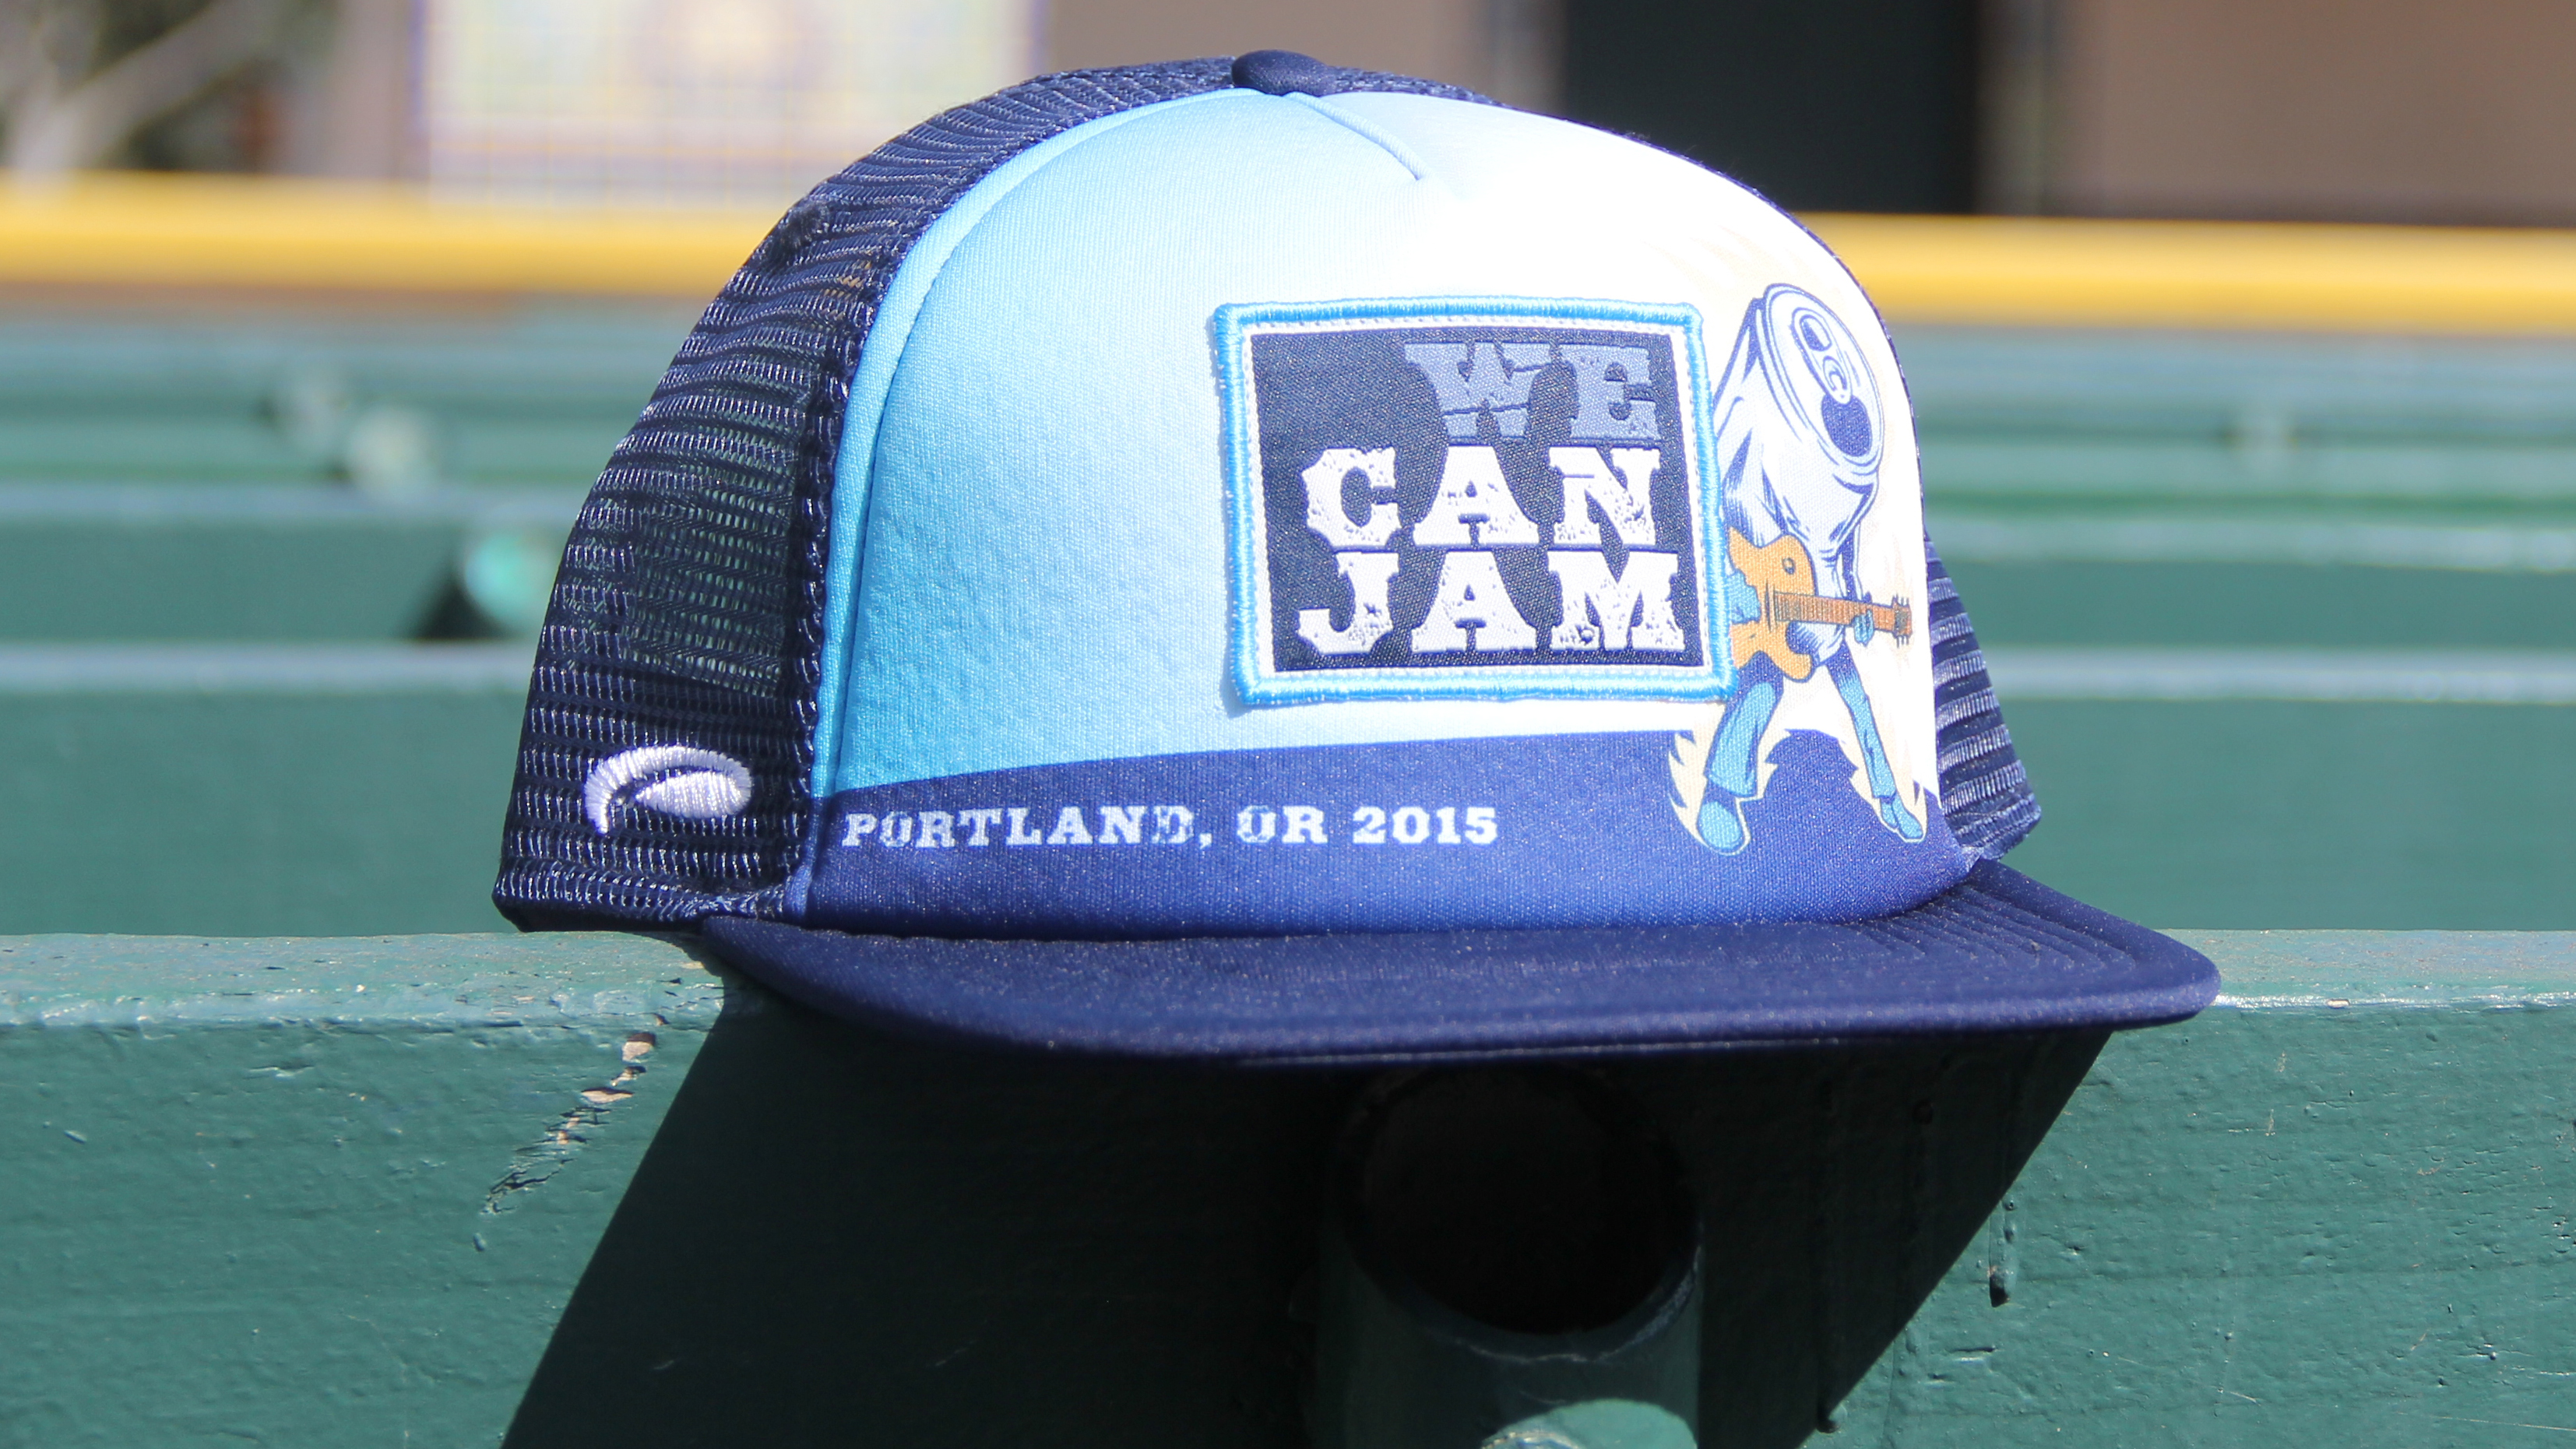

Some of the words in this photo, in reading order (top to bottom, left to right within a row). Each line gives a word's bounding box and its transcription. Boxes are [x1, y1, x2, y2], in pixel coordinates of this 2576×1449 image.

[1404, 341, 1661, 441] WE
[1302, 445, 1661, 547] CAN
[1298, 550, 1685, 655] JAM
[841, 806, 1214, 849] PORTLAND,
[1237, 805, 1328, 846] OR
[1353, 805, 1498, 846] 2015
